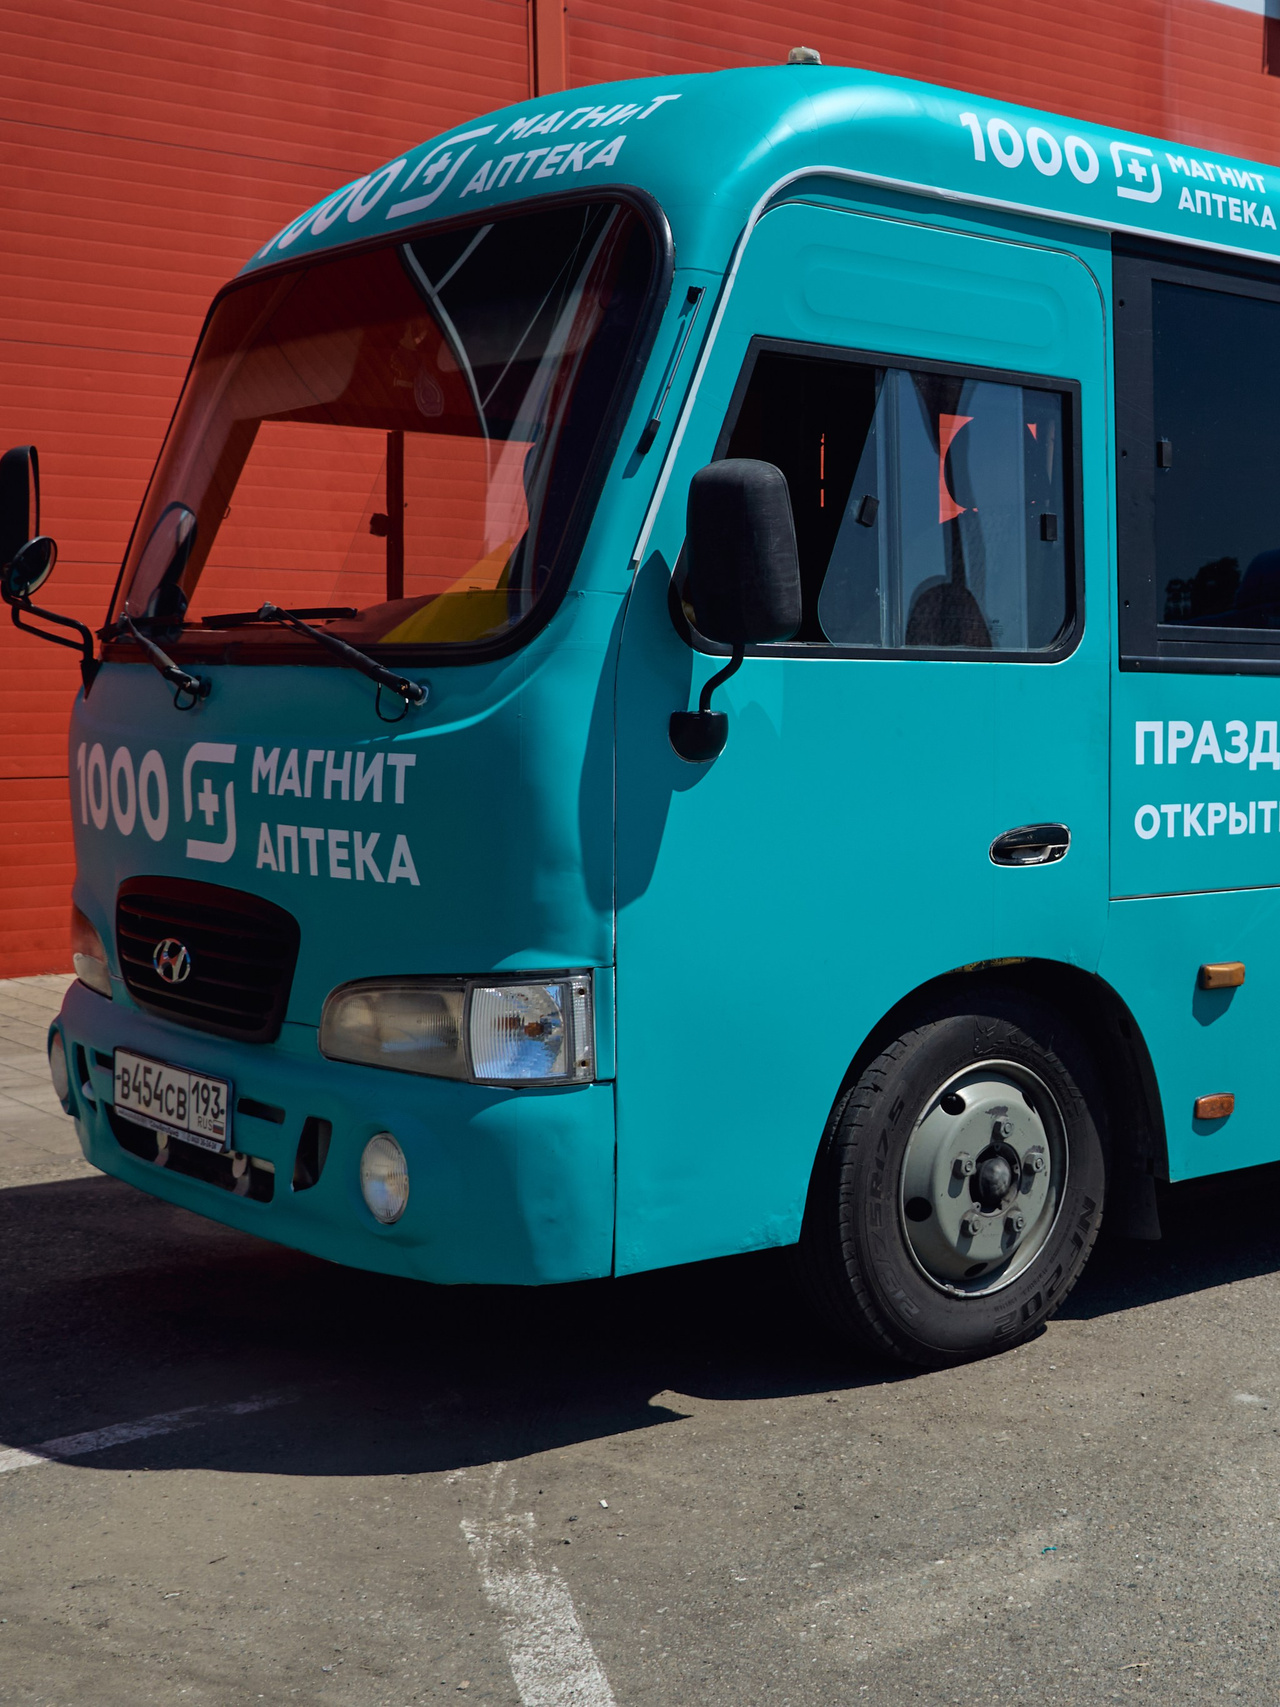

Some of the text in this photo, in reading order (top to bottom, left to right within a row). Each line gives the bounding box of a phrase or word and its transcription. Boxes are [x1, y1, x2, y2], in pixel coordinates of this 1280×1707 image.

[494, 94, 682, 145] МАГНИТ
[959, 112, 1266, 193] 1000 МАГНИТ
[259, 135, 627, 259] 1000 АПТЕКА
[1178, 187, 1277, 230] АПТЕКА
[77, 742, 416, 841] 1000 МАГНИТ
[256, 822, 421, 886] АПТЕКА
[191, 1081, 220, 1119] 193
[198, 1116, 213, 1131] RUS
